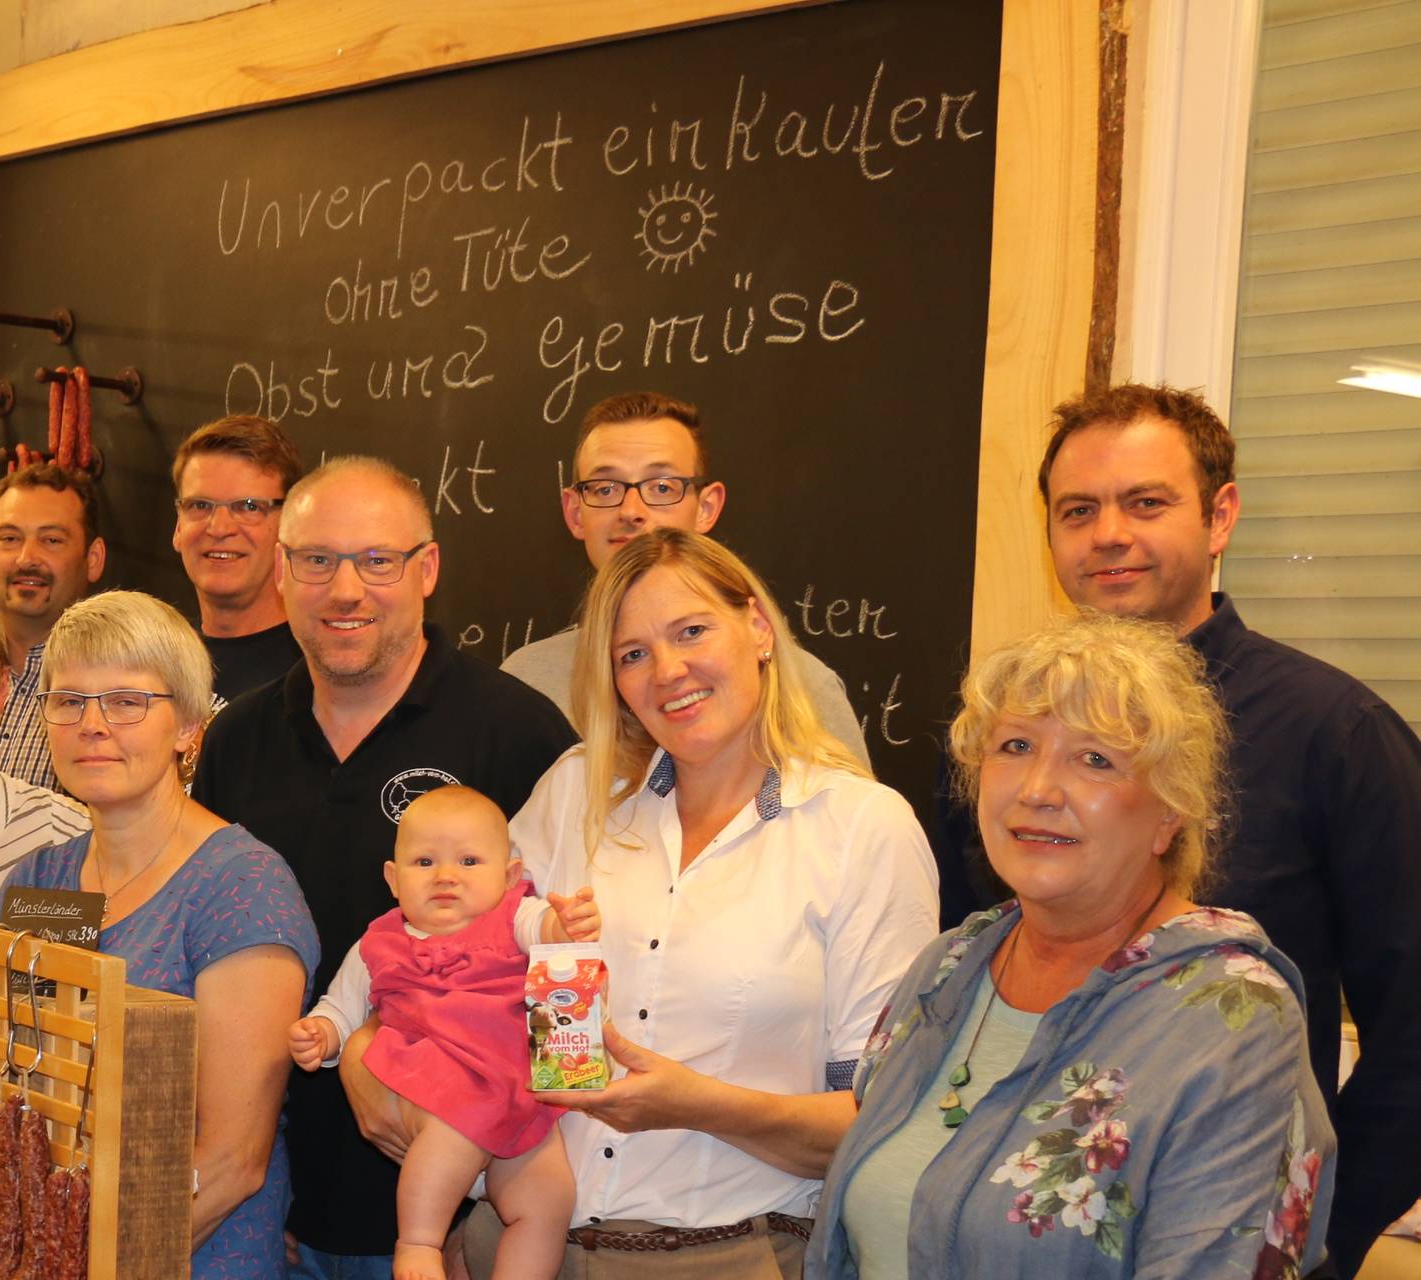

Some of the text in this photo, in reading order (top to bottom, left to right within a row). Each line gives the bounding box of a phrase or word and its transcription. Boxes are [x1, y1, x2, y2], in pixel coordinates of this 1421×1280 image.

[217, 111, 573, 260] Unverpackt
[325, 216, 592, 325] ohne Tüte
[225, 348, 342, 423] Obst
[367, 325, 495, 400] und
[8, 898, 83, 916] Münsterländer
[547, 1031, 590, 1045] Milch
[572, 1045, 590, 1053] Hof
[564, 1063, 600, 1081] Erdbeer
